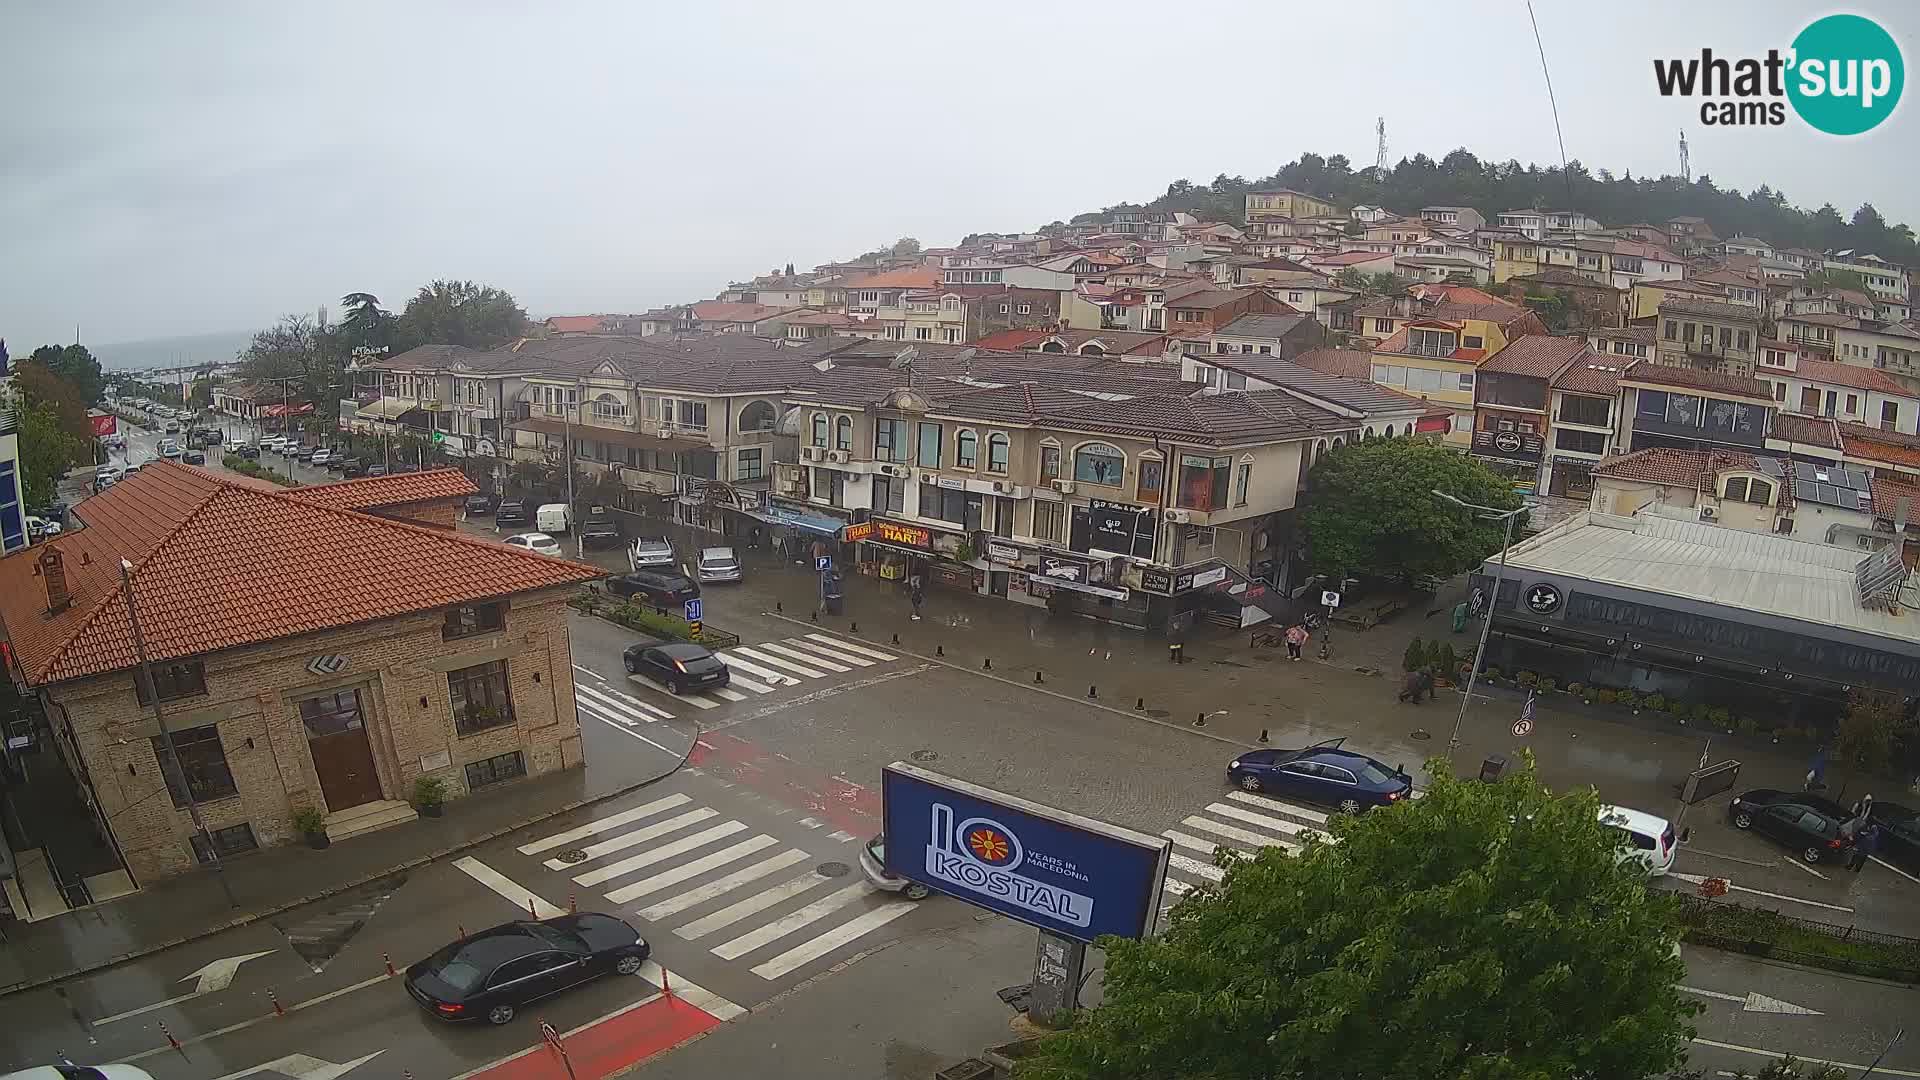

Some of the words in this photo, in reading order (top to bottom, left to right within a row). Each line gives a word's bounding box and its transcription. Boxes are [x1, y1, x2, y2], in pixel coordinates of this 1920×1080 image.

[819, 558, 828, 569] P
[1026, 857, 1090, 883] MACEDONIA
[1027, 850, 1063, 868] YEARS
[1065, 860, 1077, 872] IN
[935, 851, 1080, 921] KOSTAL
